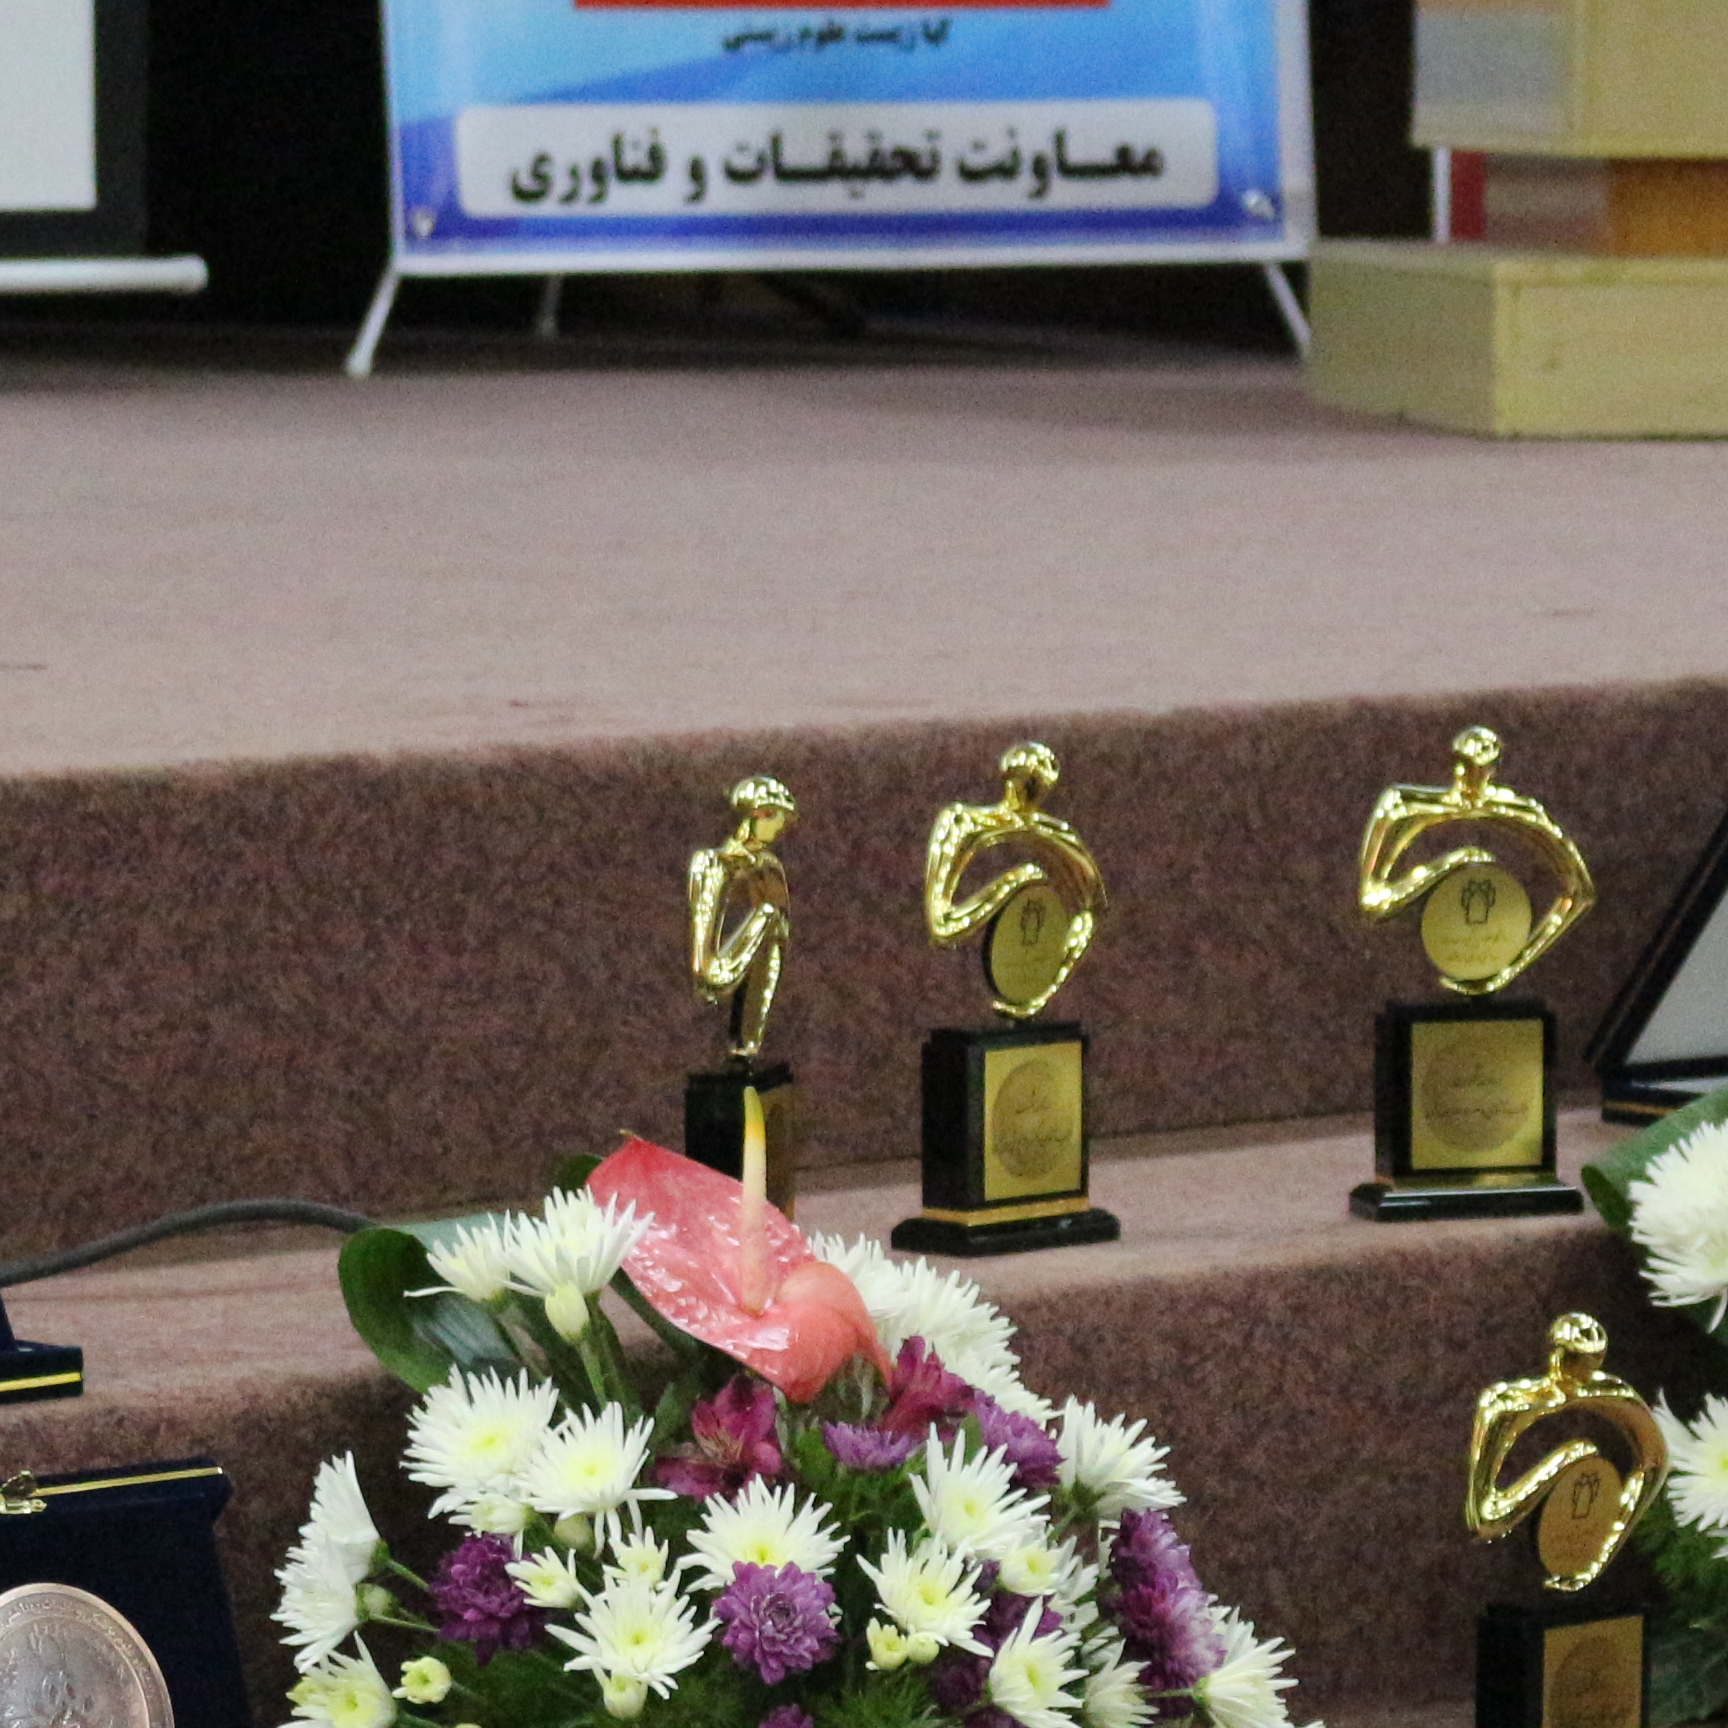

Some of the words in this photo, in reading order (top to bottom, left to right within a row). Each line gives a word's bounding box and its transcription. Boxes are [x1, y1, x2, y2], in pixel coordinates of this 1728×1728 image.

[510, 125, 667, 205] فناوری
[683, 154, 707, 205] و
[723, 128, 942, 200] تحقیقات
[957, 125, 1164, 200] معاونت
